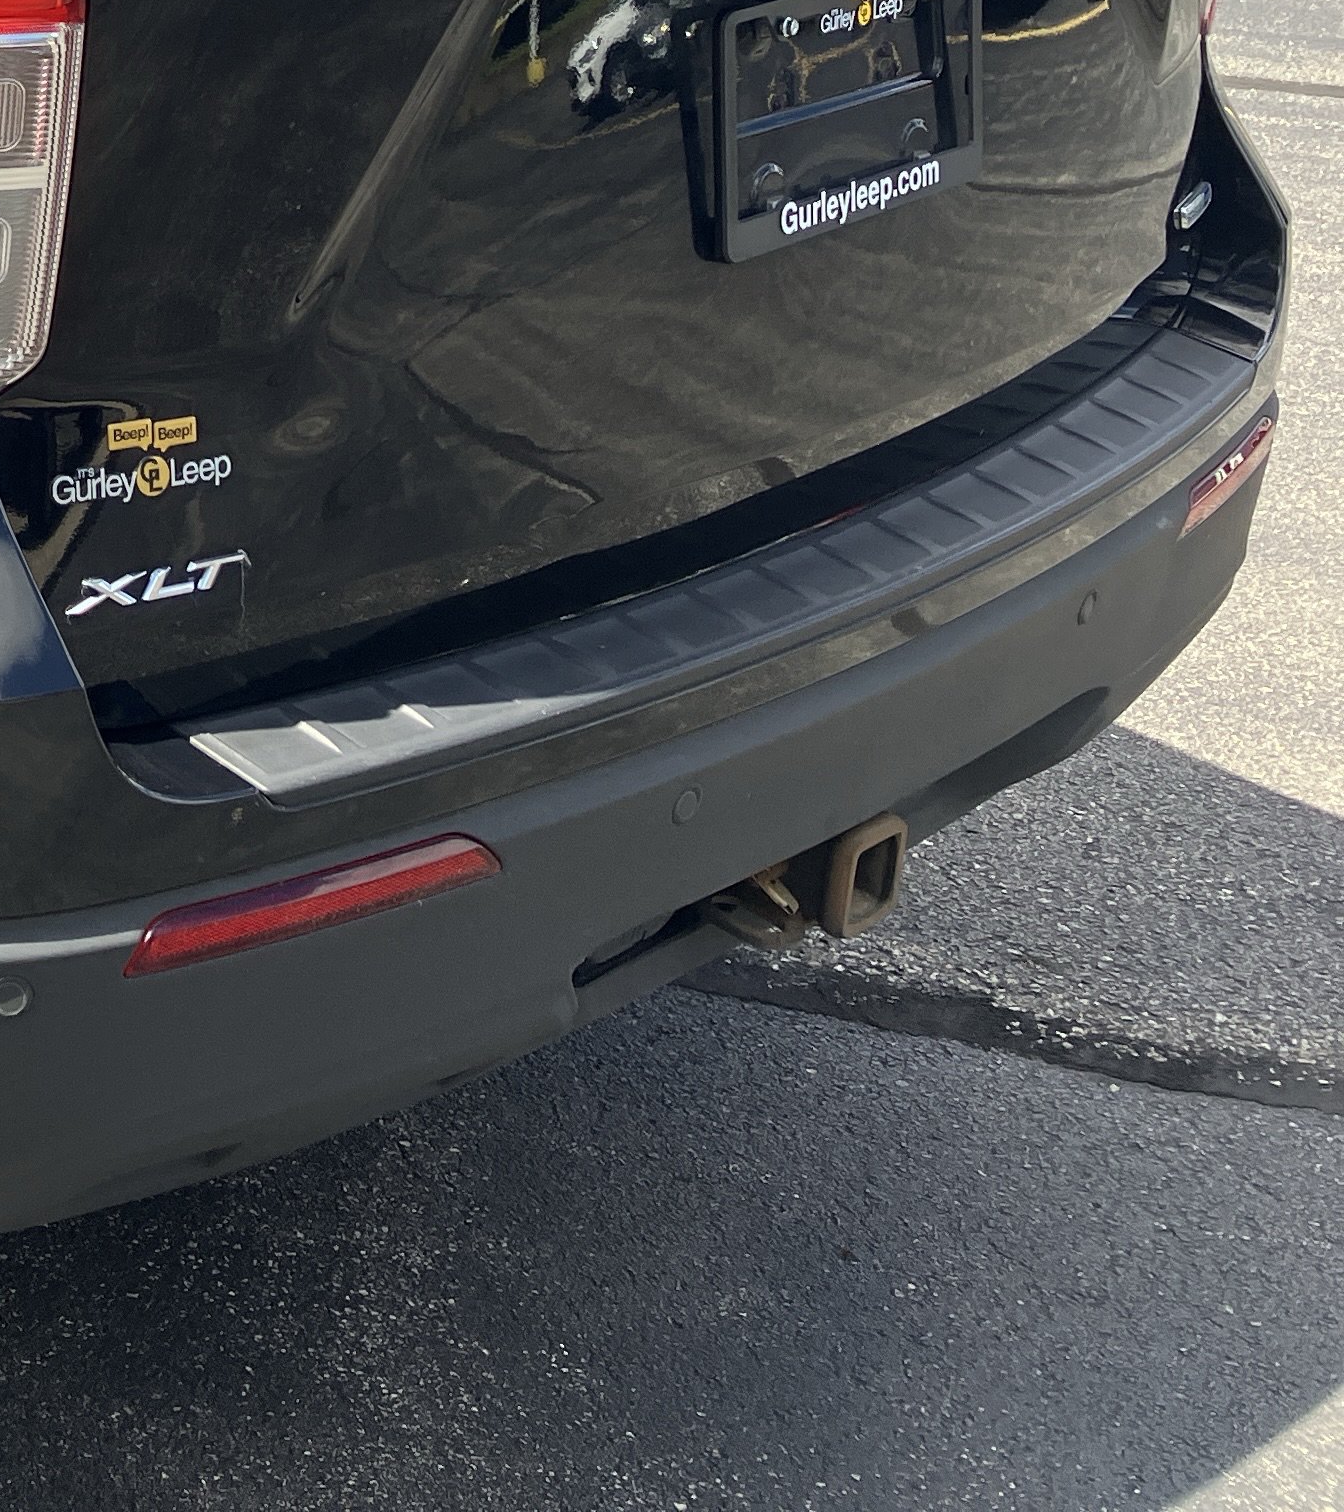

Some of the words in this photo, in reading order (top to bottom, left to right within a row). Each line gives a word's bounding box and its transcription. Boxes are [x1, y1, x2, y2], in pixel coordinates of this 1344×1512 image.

[820, 7, 856, 34] Gurley
[780, 160, 940, 235] Gurleyleep.com
[113, 424, 150, 442] Beep!
[158, 422, 193, 441] Beep!
[52, 467, 138, 505] Gurley
[170, 454, 232, 486] Leep
[65, 551, 250, 616] XLT
